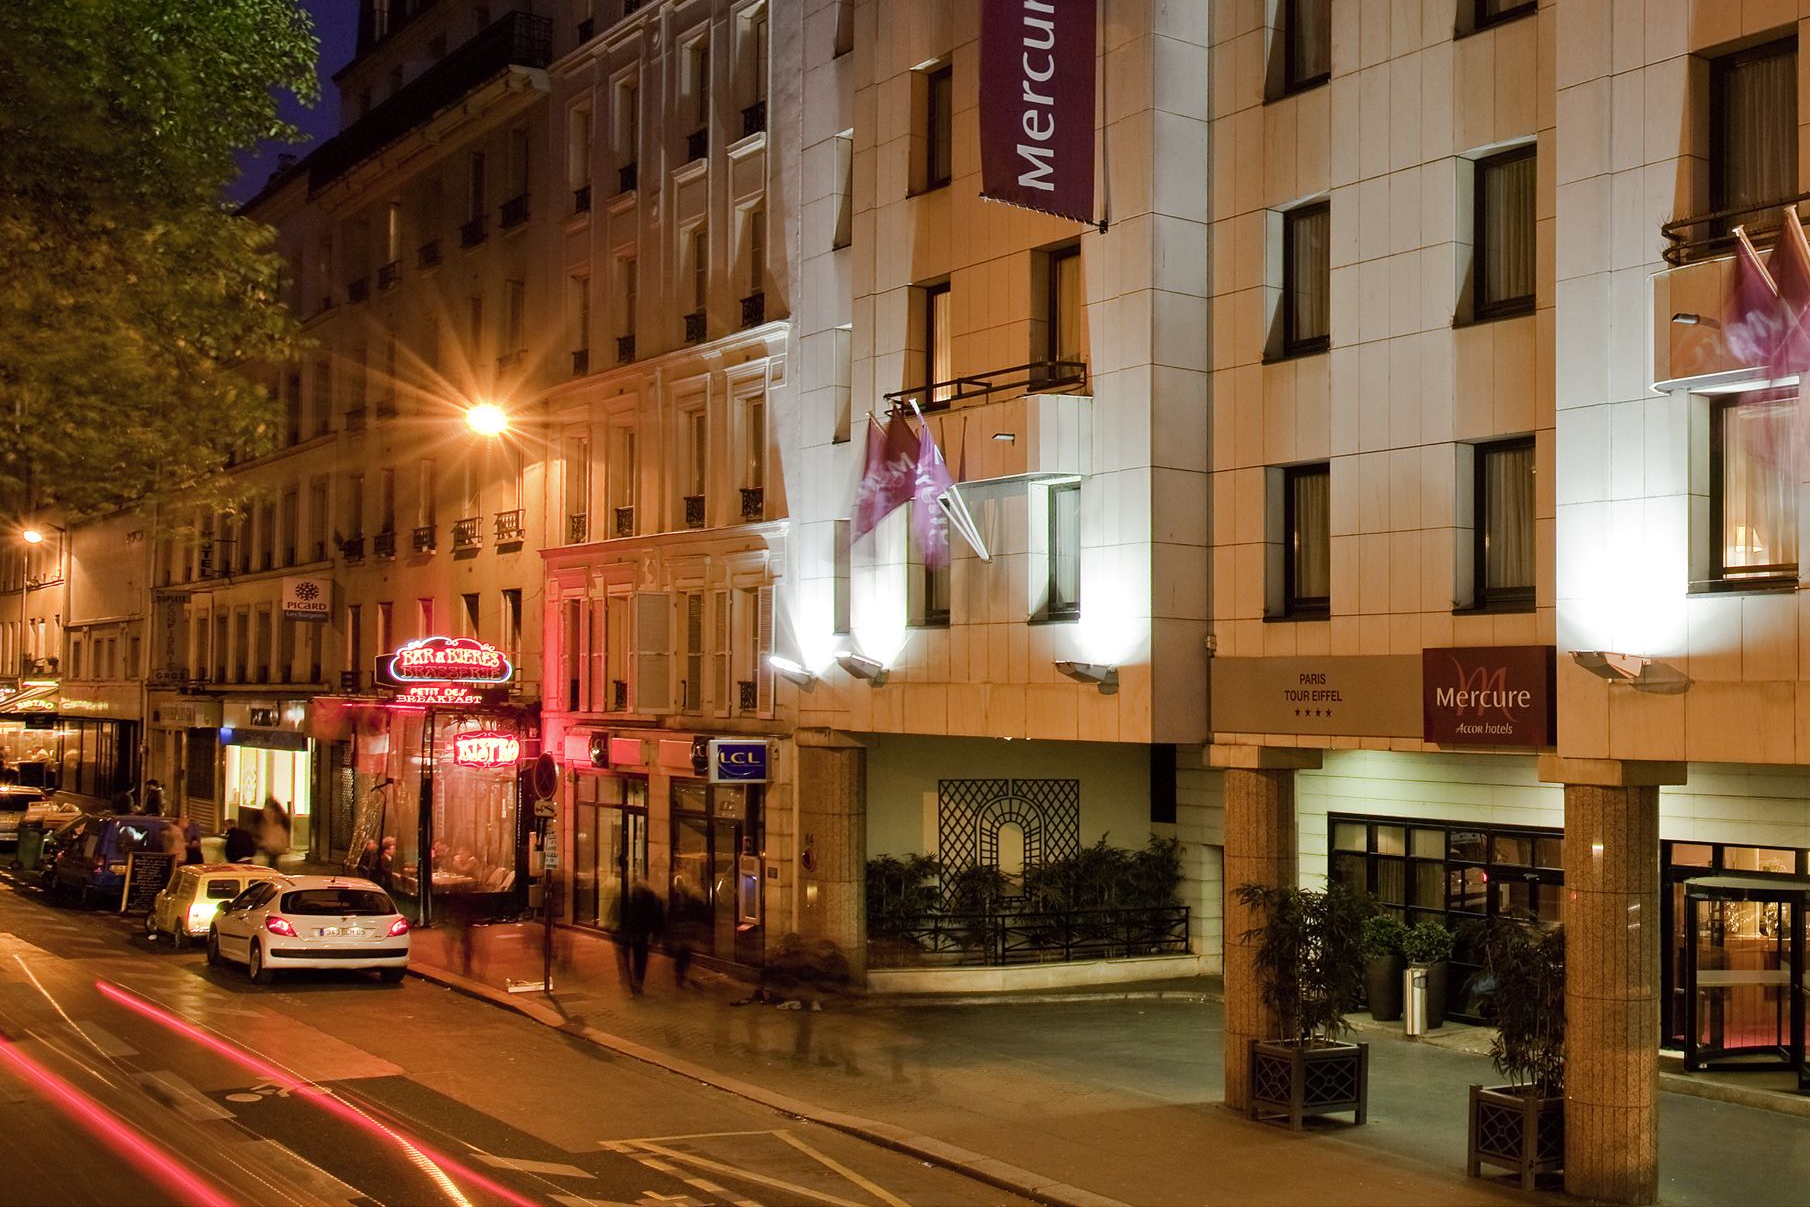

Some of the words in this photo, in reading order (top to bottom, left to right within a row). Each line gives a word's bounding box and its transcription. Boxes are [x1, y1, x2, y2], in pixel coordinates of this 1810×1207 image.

[401, 648, 435, 666] BAR
[155, 672, 186, 680] GROS
[400, 665, 501, 680] BRASSERIE
[1299, 673, 1327, 685] PARIS
[410, 687, 440, 696] PETIT
[1284, 690, 1310, 702] TOUR
[1312, 690, 1343, 702] EIFFEL
[1436, 687, 1531, 708] Mercure
[396, 695, 483, 704] BREAKFAST
[1485, 722, 1513, 735] hotels
[456, 738, 520, 763] BISTRO
[720, 751, 761, 764] LCL
